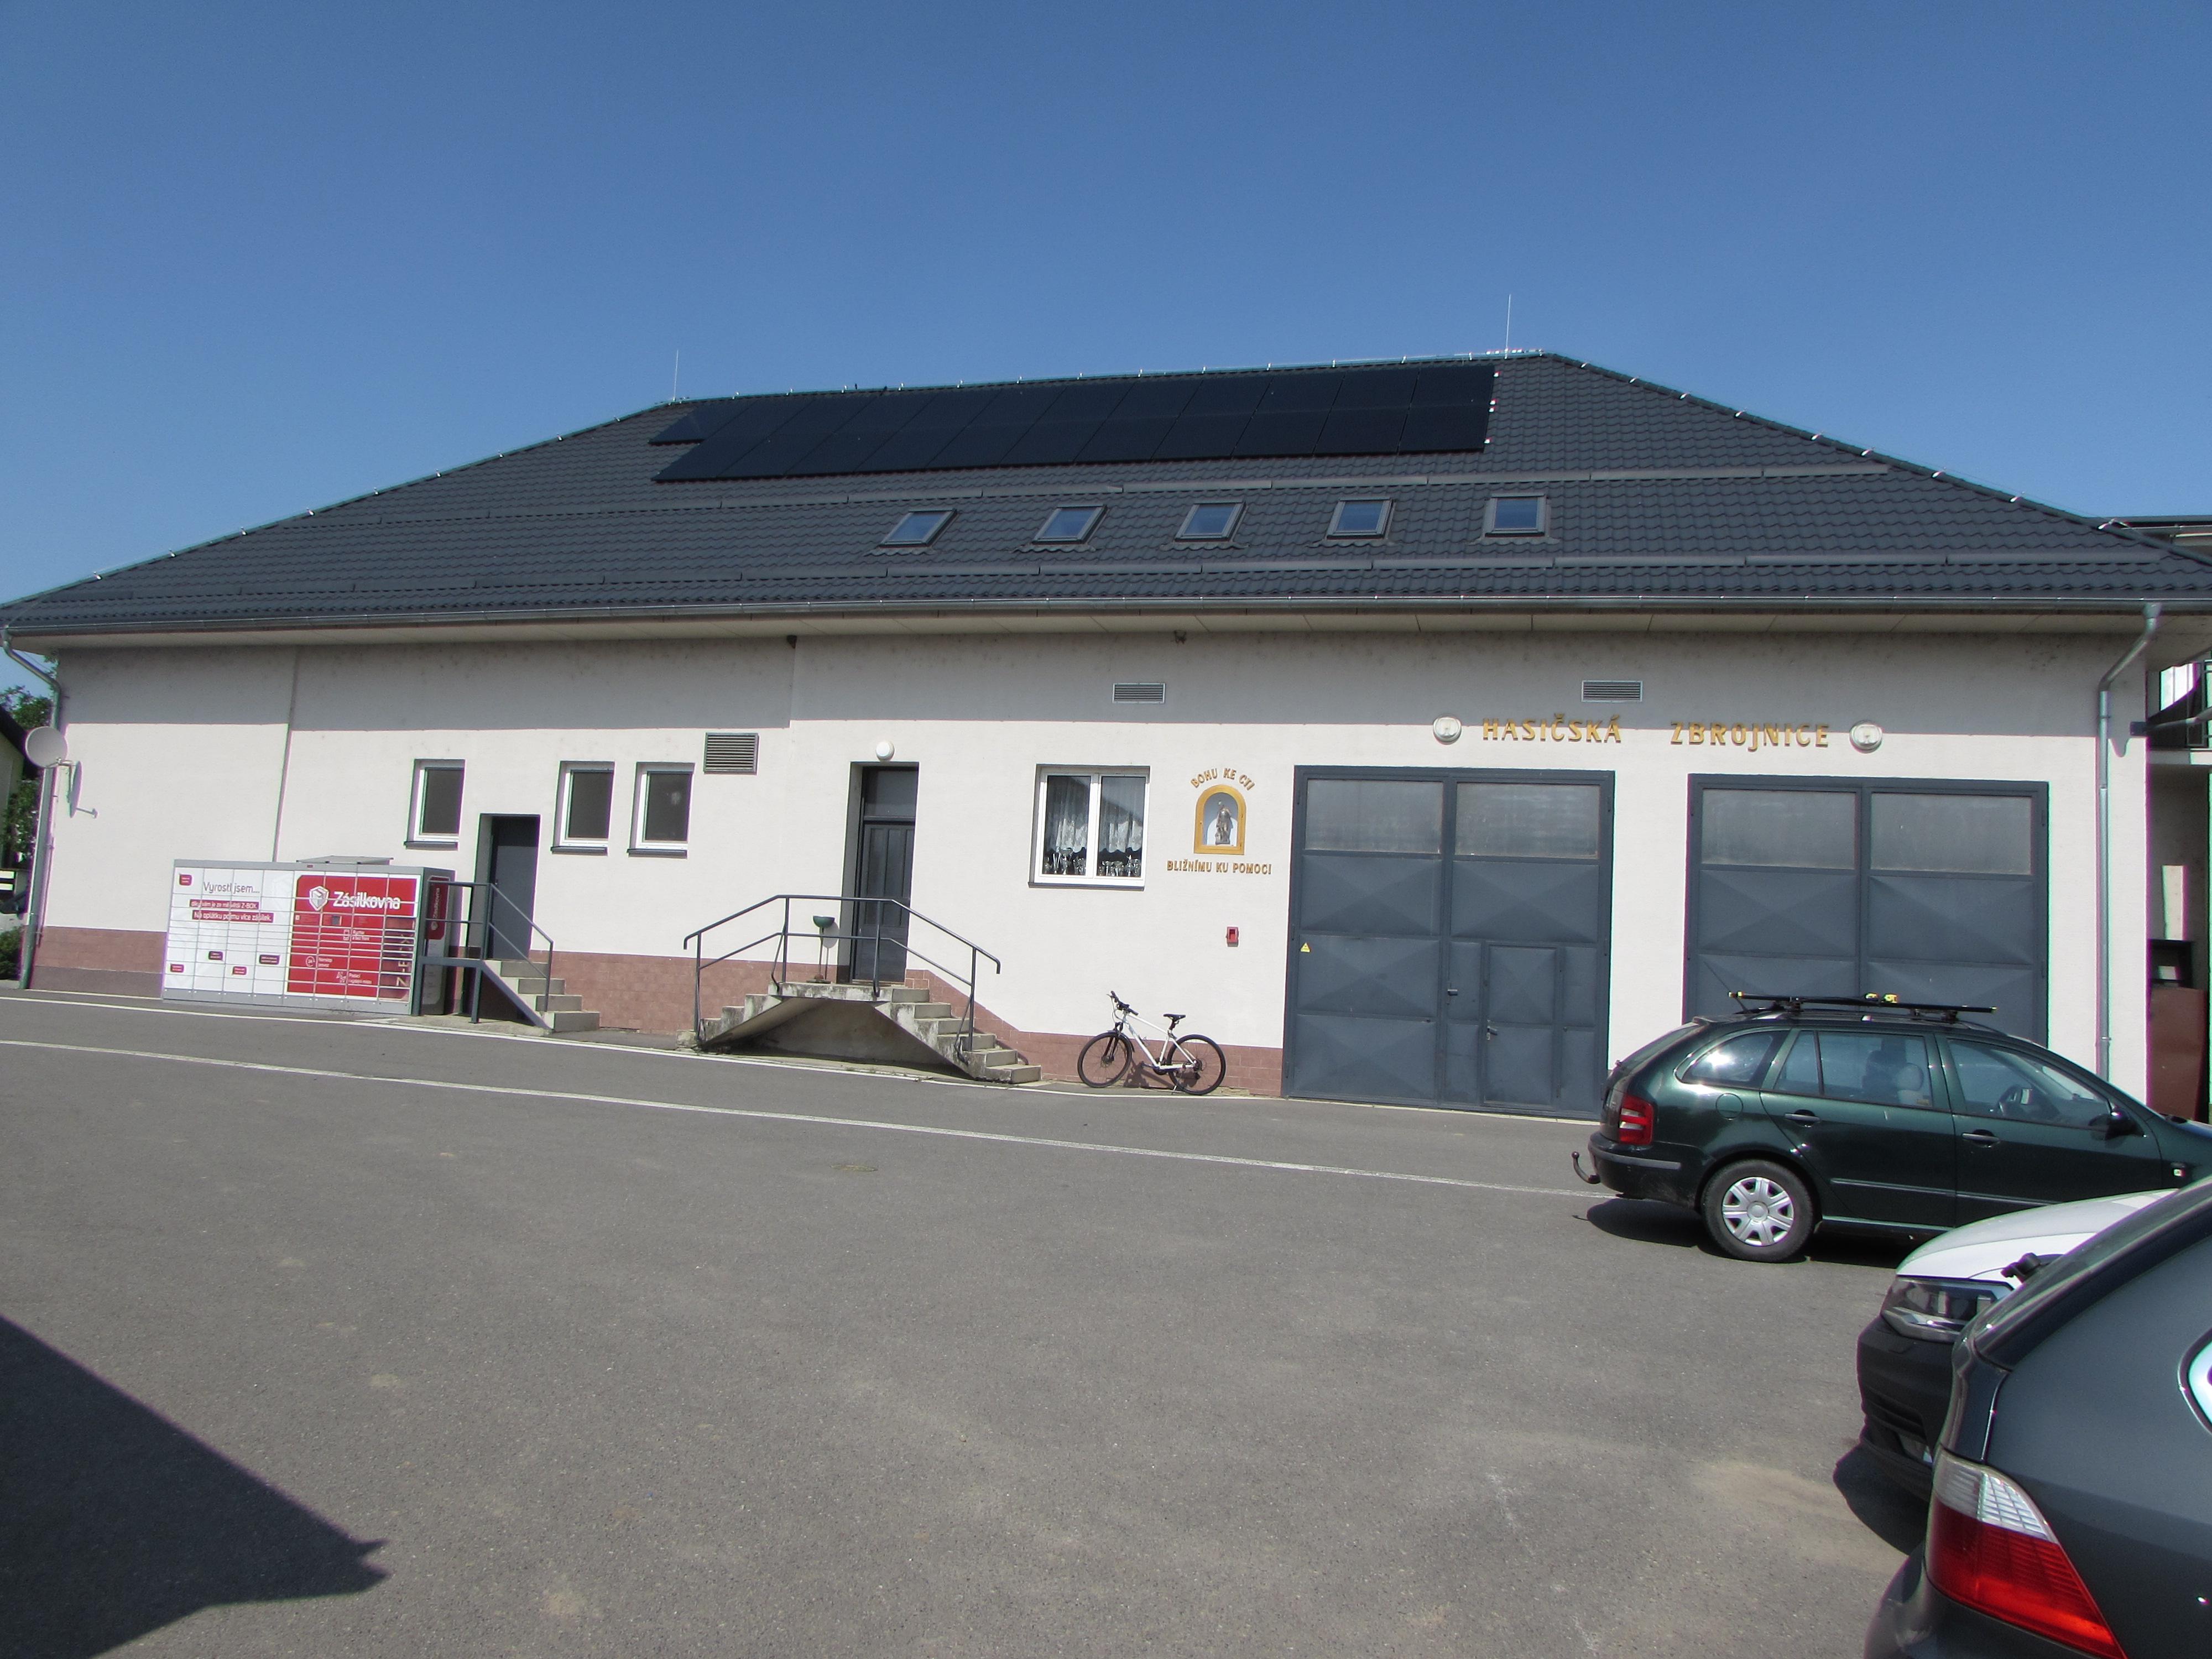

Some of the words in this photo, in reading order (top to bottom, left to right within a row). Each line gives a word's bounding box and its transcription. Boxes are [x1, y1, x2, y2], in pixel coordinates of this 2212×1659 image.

[1482, 713, 1622, 743] HASIČSKÁ
[1670, 722, 1828, 752] ZBROJNICE
[1190, 768, 1218, 788] BOHU
[1223, 768, 1237, 780] KE
[1239, 774, 1256, 791] CTI
[1167, 858, 1212, 872] BLIŽNÍMU
[1216, 862, 1228, 873] KU
[1233, 863, 1271, 874] POMOCI
[204, 882, 232, 894] Vyrostl
[333, 891, 401, 910] Zásilkovna
